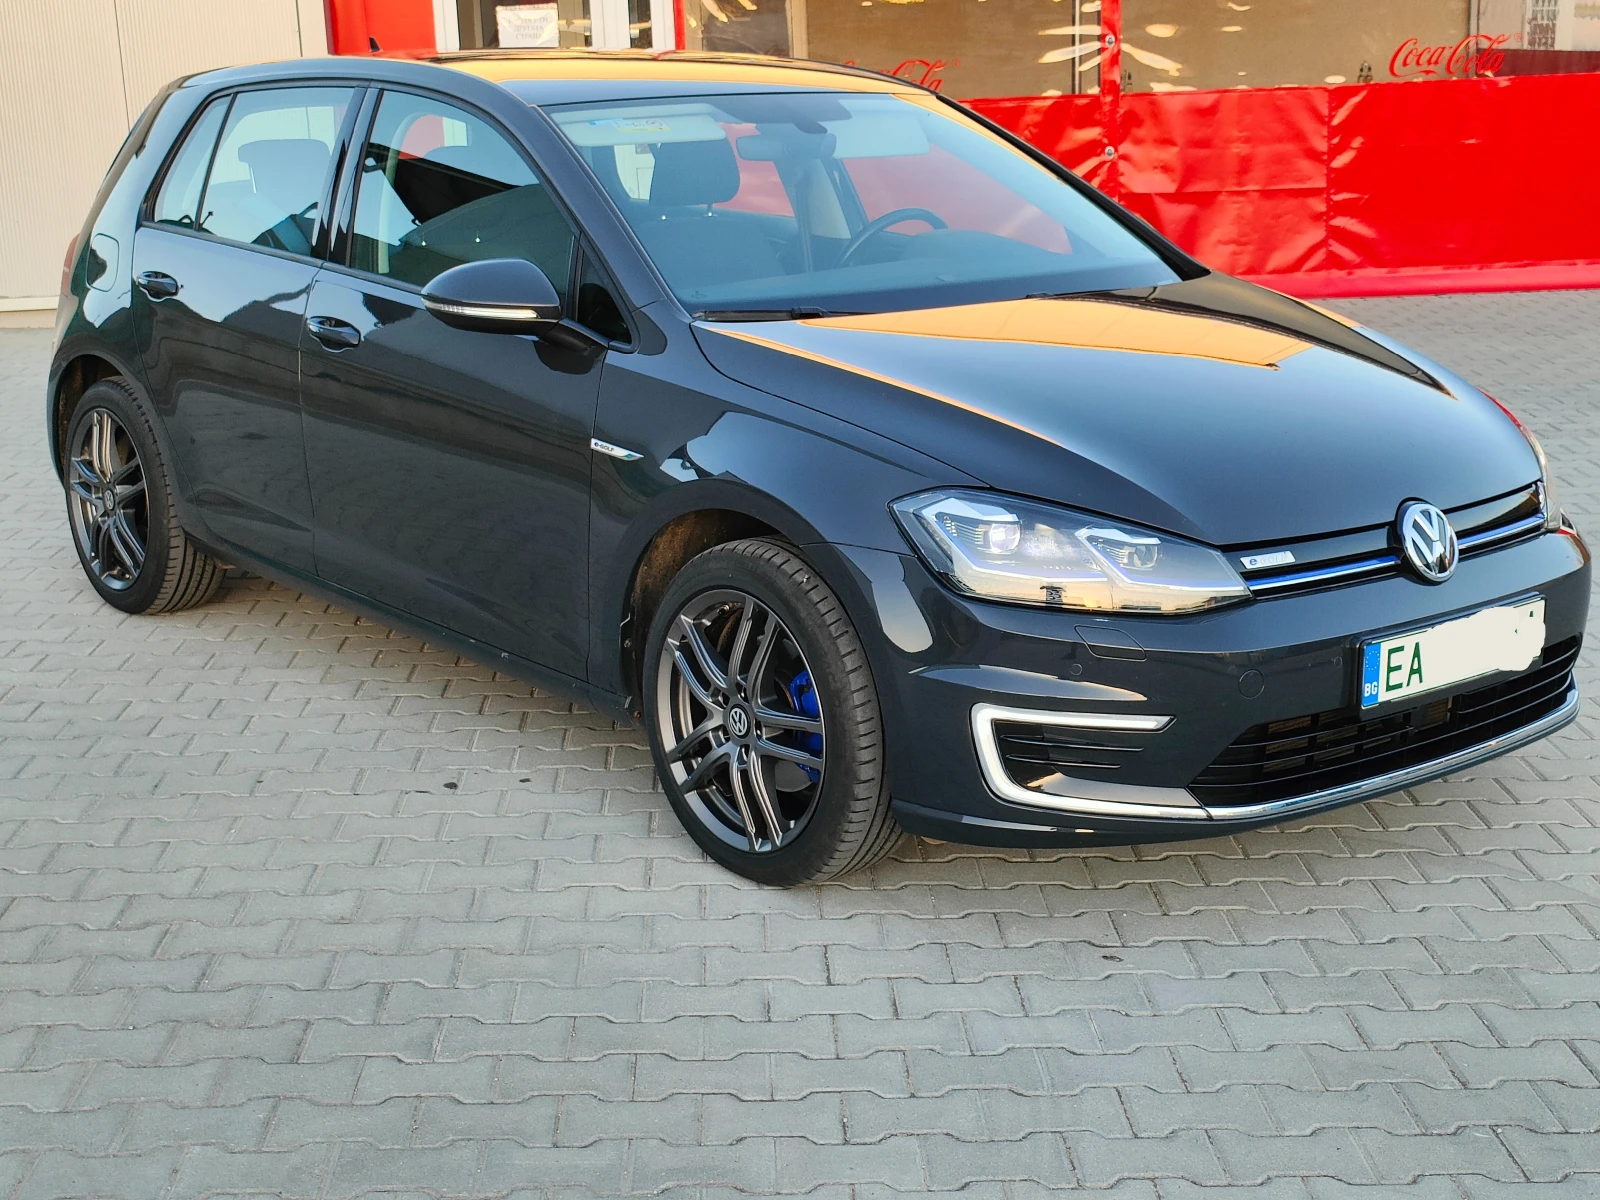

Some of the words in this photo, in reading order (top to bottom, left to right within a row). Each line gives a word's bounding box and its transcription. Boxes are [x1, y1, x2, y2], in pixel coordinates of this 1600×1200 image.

[1389, 33, 1510, 77] Coca-Cola
[594, 442, 614, 452] e-GOLF
[1385, 641, 1423, 692] EA
[1364, 681, 1378, 697] BG
